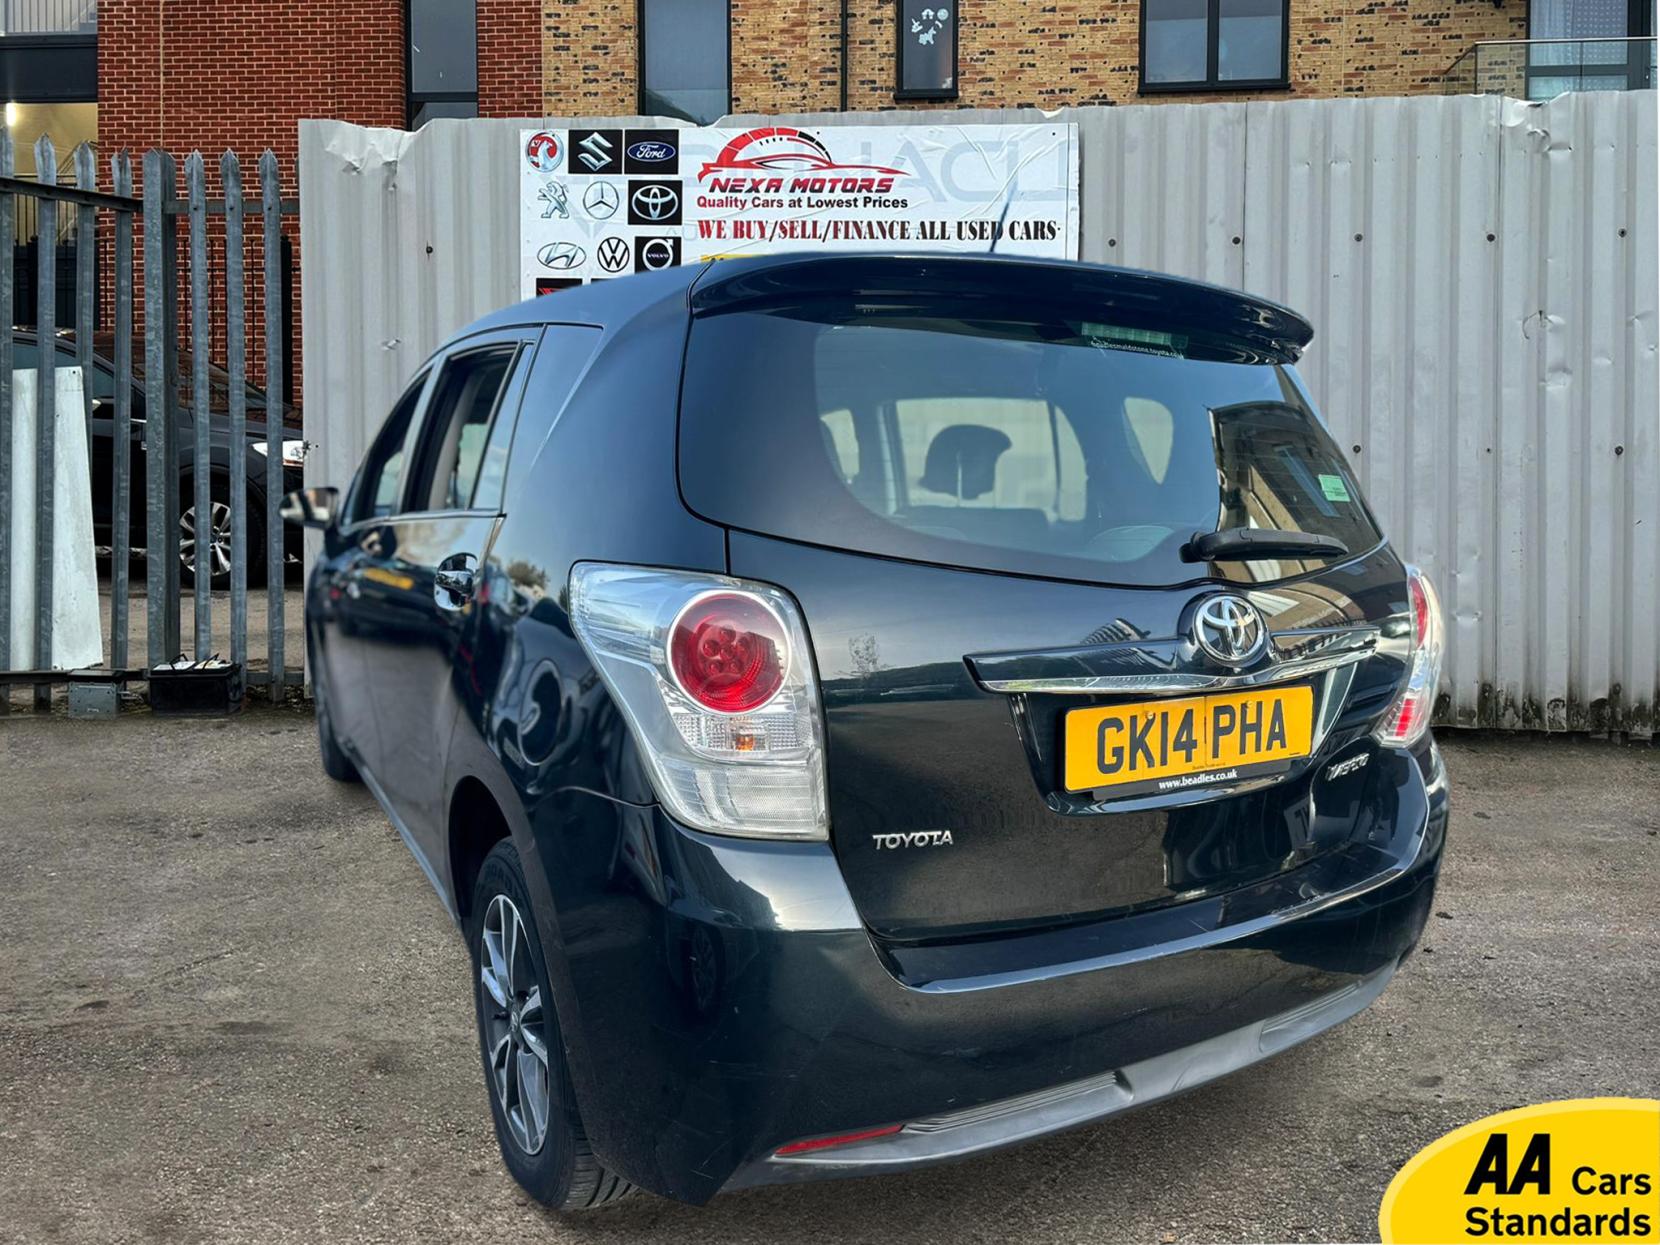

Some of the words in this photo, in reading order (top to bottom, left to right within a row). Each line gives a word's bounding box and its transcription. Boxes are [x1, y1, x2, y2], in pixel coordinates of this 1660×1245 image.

[636, 144, 666, 159] Ford
[708, 177, 783, 194] NEXA
[788, 177, 894, 194] MOTORS
[696, 196, 747, 211] Quality
[751, 196, 783, 208] Cars
[788, 197, 803, 208] at
[807, 196, 859, 208] Lowest
[863, 196, 908, 208] Prices
[697, 219, 727, 240] WE
[732, 219, 911, 243] BUY/SELL/FINANCE
[916, 220, 951, 241] ALL
[956, 220, 1004, 241] USED
[1008, 220, 1057, 241] CARS
[1096, 708, 1198, 775] GK14
[1211, 698, 1287, 760] PHA
[1158, 768, 1238, 790] www.beadles.co.uk
[872, 830, 953, 850] TOYOTA
